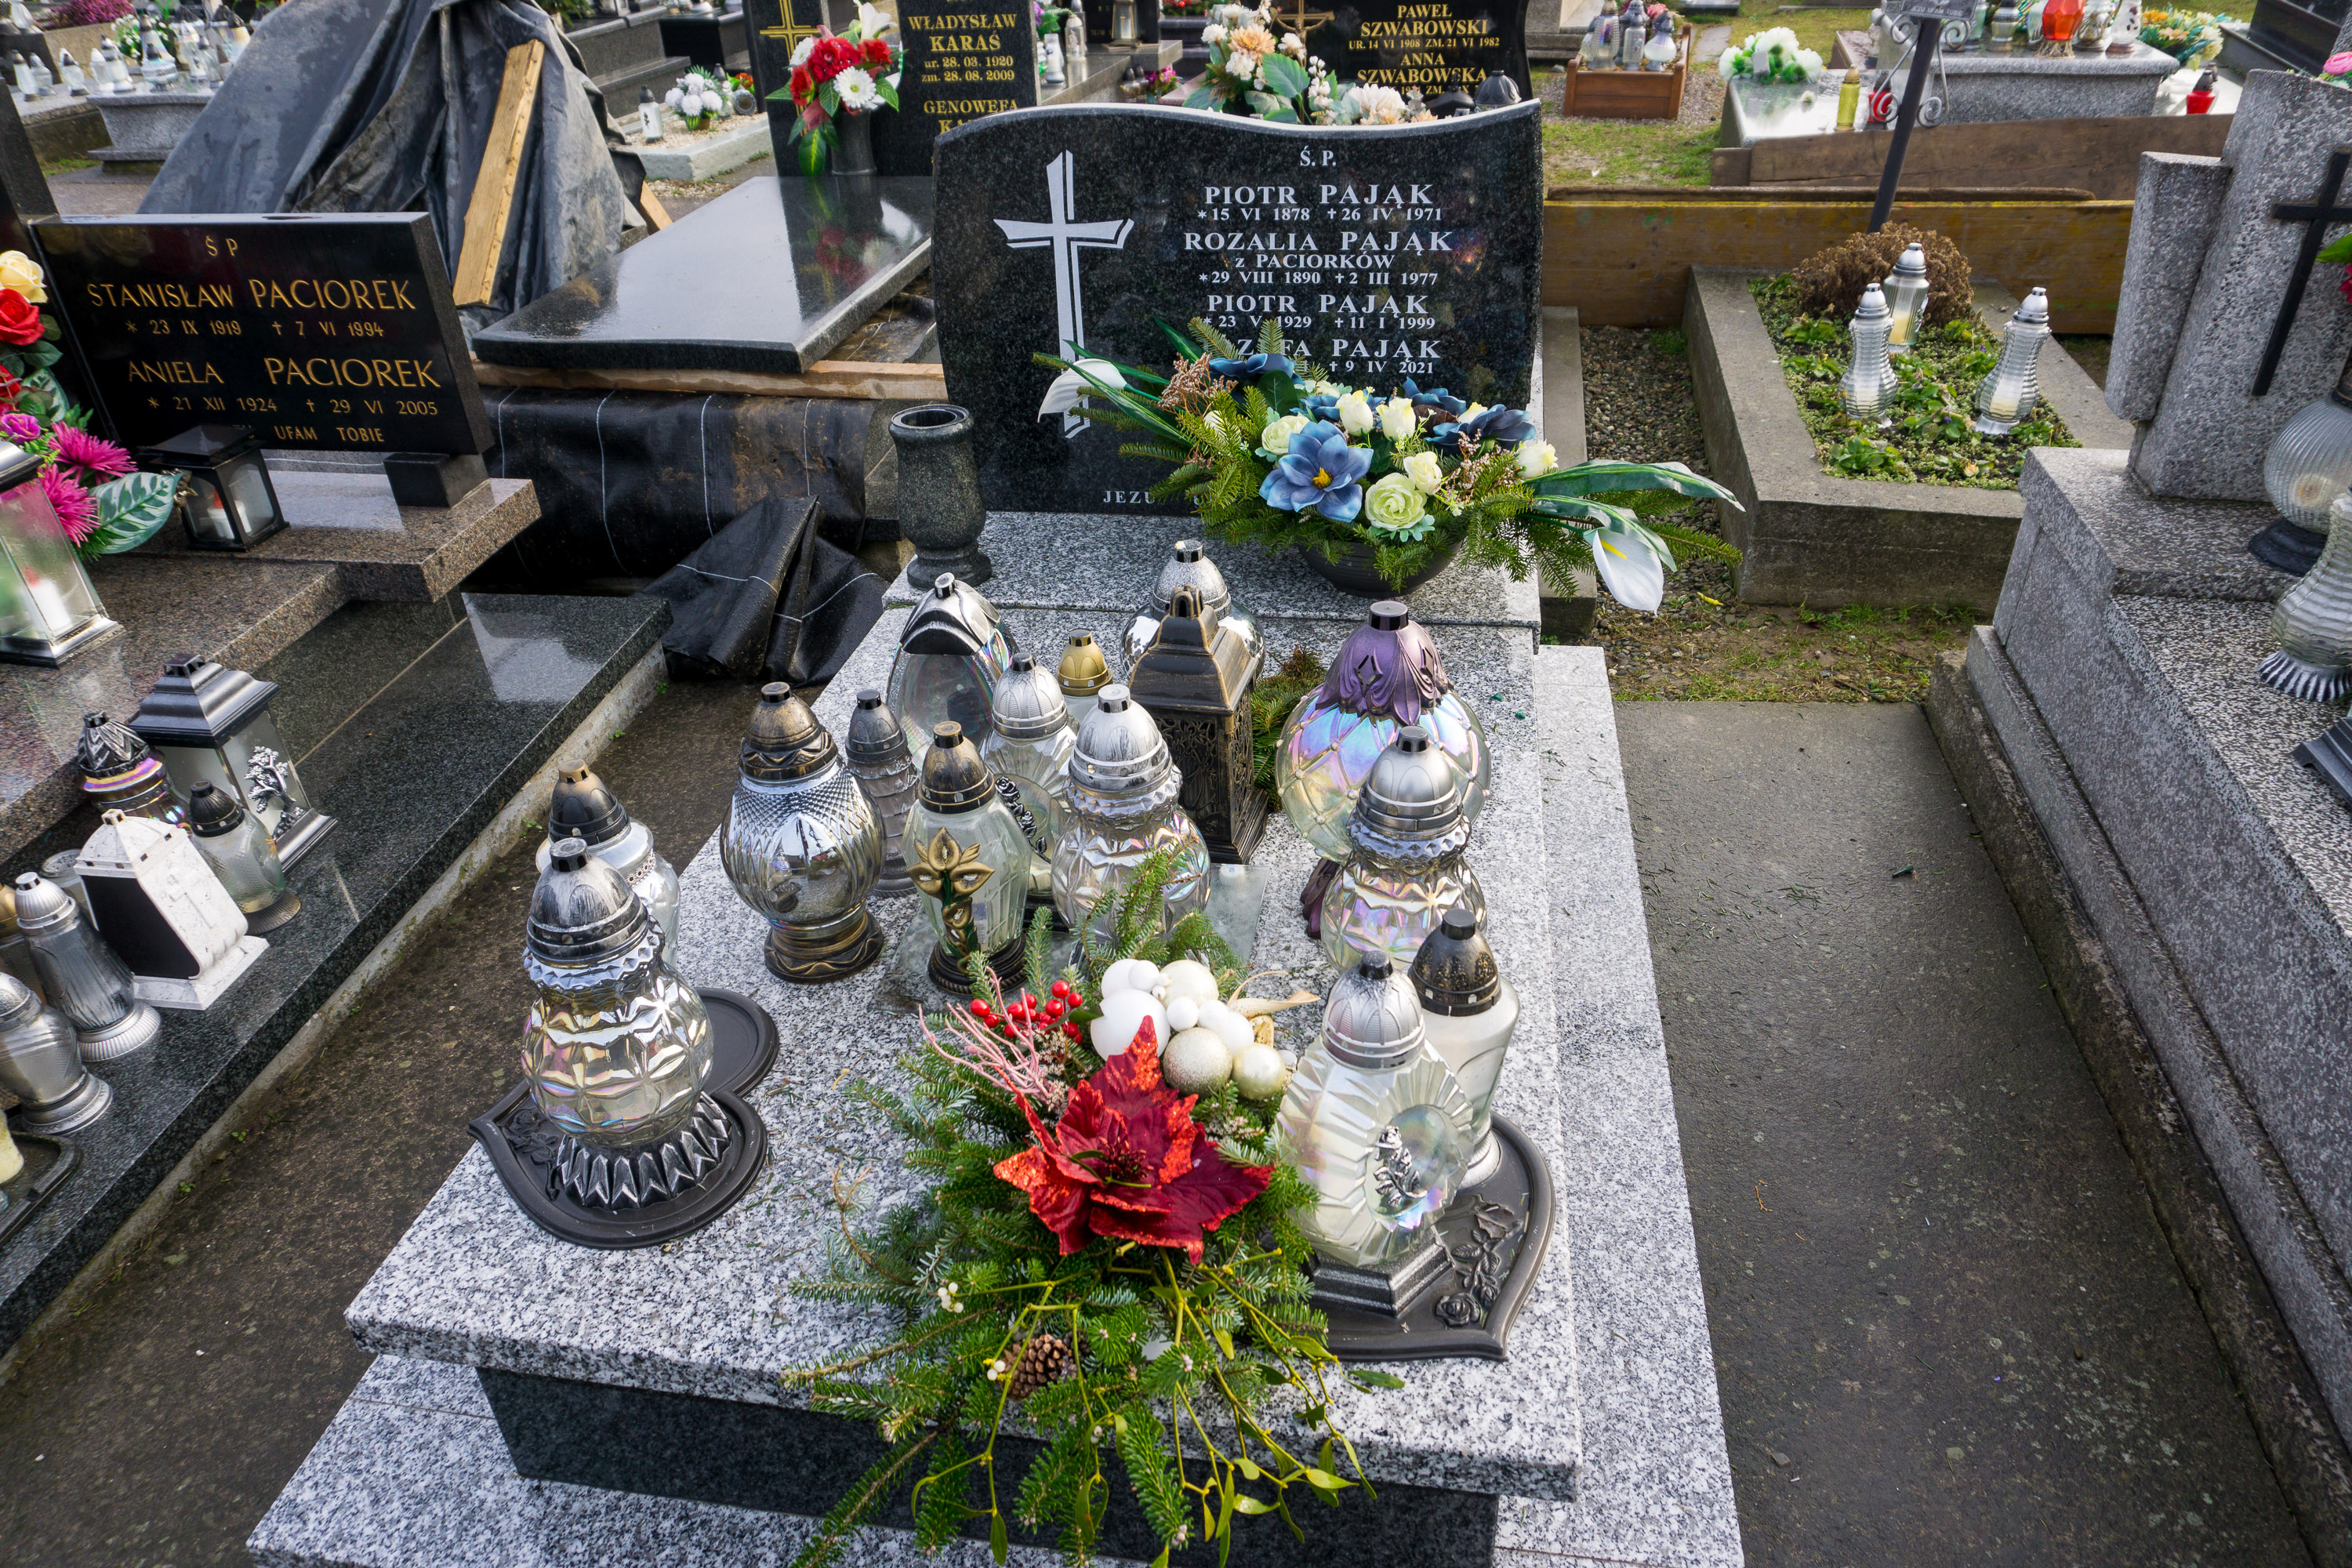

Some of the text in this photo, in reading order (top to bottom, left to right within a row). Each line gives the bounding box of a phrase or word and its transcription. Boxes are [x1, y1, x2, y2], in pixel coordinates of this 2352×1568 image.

[1396, 4, 1453, 19] PAWEŁ
[907, 13, 1017, 30] WŁADYSŁAW
[1361, 19, 1488, 37] SZWABOWSKI
[929, 30, 1001, 52] KARAŚ
[1348, 40, 1366, 50] UR.
[1384, 39, 1395, 49] VI
[1400, 38, 1421, 49] 1908
[1425, 38, 1445, 48] ZM.
[1462, 38, 1474, 47] VI
[1479, 37, 1500, 47] 1982
[924, 60, 939, 69] ur.
[942, 56, 960, 68] 28.
[985, 55, 1014, 67] 1920
[1400, 52, 1445, 66] ANNA
[944, 71, 962, 82] 28.
[985, 69, 1015, 81] 2009
[1357, 67, 1486, 83] SZWABOWSKA
[924, 99, 1018, 114] GENOWEFA
[1300, 146, 1337, 166] Ś. P.
[1204, 184, 1434, 209] PIOTR PAJĄK
[1240, 208, 1261, 221] VI
[1273, 208, 1310, 221] 1878
[1373, 208, 1394, 221] IV
[1406, 207, 1442, 221] 1971
[205, 235, 238, 256] Ś P
[1184, 230, 1453, 256] ROZALIA PAJĄK
[1235, 251, 1396, 269] z PACIORKÓW
[1240, 271, 1273, 284] VIII
[1285, 271, 1321, 285] 1890
[1369, 272, 1389, 285] III
[1401, 272, 1439, 285] 1977
[86, 278, 416, 309] STANISŁAW PACIOREK
[1207, 294, 1428, 318] PIOTR PAJĄK
[149, 319, 384, 337] 23 IX 1919 7 VI 1994
[1218, 315, 1236, 328] 23
[1249, 315, 1263, 328] V
[1277, 315, 1312, 328] 1929
[1378, 317, 1385, 328] I
[1399, 317, 1436, 330] 1999
[1331, 339, 1441, 363] PAJĄK
[129, 357, 441, 387] ANIELA PACIOREK
[1367, 361, 1387, 373] IV
[1399, 361, 1434, 374] 2021
[172, 397, 438, 416] 21 XII 1924 29 VI 2005
[274, 425, 318, 441] UFAM
[336, 426, 384, 443] TOBIE
[1103, 490, 1156, 504] JEZU
